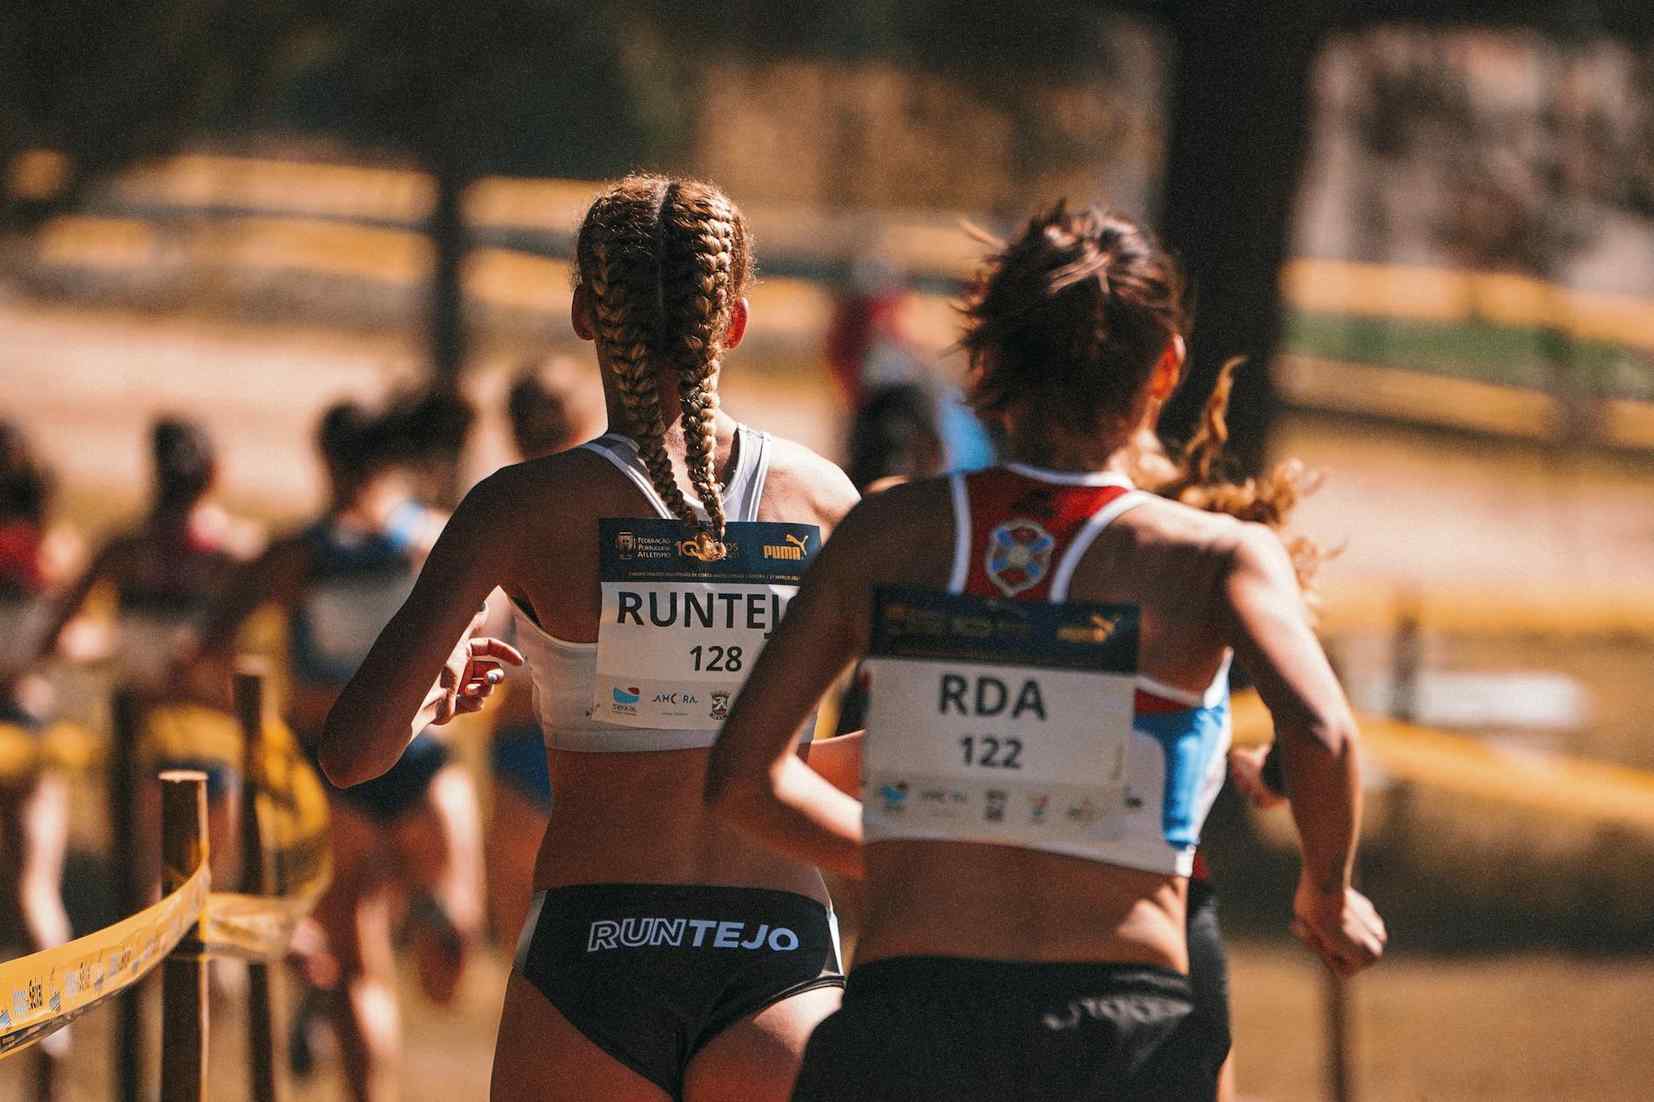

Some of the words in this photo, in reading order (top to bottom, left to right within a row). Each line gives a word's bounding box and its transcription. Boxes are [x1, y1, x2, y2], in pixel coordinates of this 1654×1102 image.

[763, 544, 801, 560] PUMA
[617, 591, 782, 640] RUNTEJ
[690, 645, 743, 672] 128
[938, 673, 1047, 721] RDA
[959, 736, 1023, 770] 122
[587, 918, 800, 952] RUNTEJO
